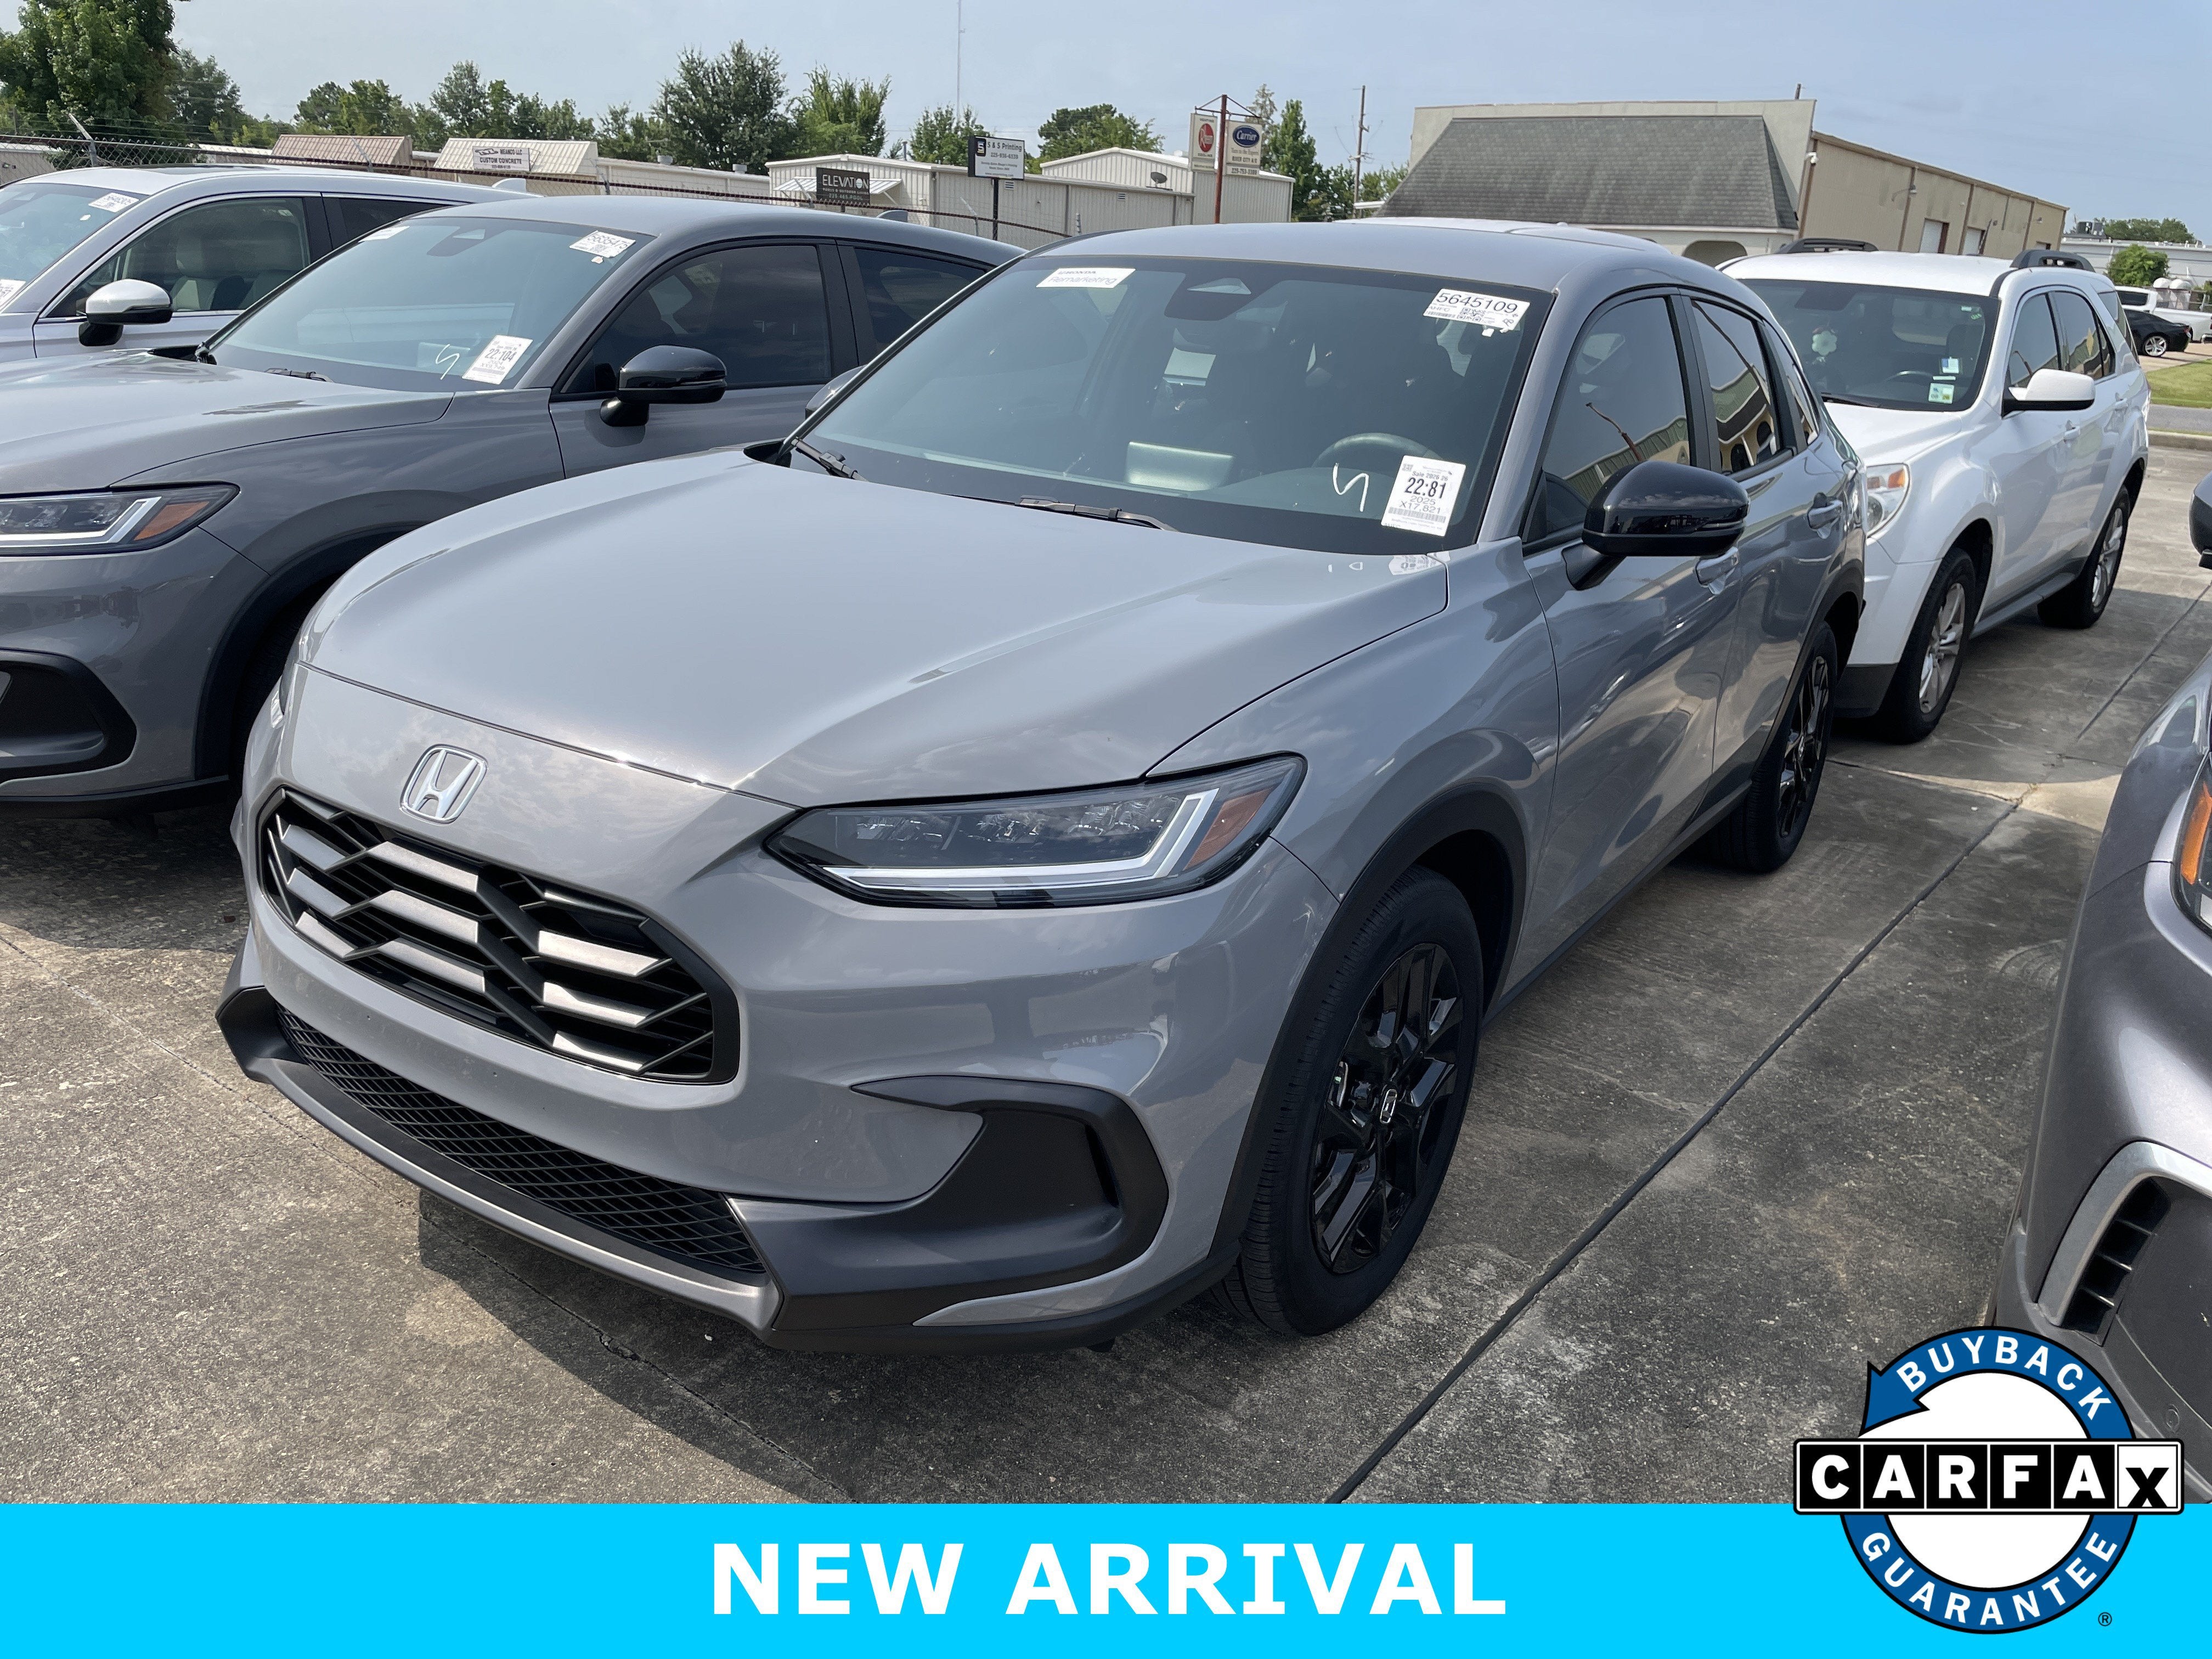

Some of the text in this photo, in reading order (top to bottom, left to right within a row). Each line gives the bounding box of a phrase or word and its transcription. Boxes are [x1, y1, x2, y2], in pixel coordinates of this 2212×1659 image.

[1236, 130, 1257, 140] Carrier
[1002, 143, 1022, 152] Printing
[822, 174, 869, 189] ELEVATION
[1048, 276, 1118, 285] Remarketing
[1436, 292, 1518, 313] 5645109
[484, 348, 517, 362] 22:104
[1404, 477, 1446, 499] 22:81
[1399, 500, 1441, 514] X17,821
[1409, 495, 1436, 505] 2025
